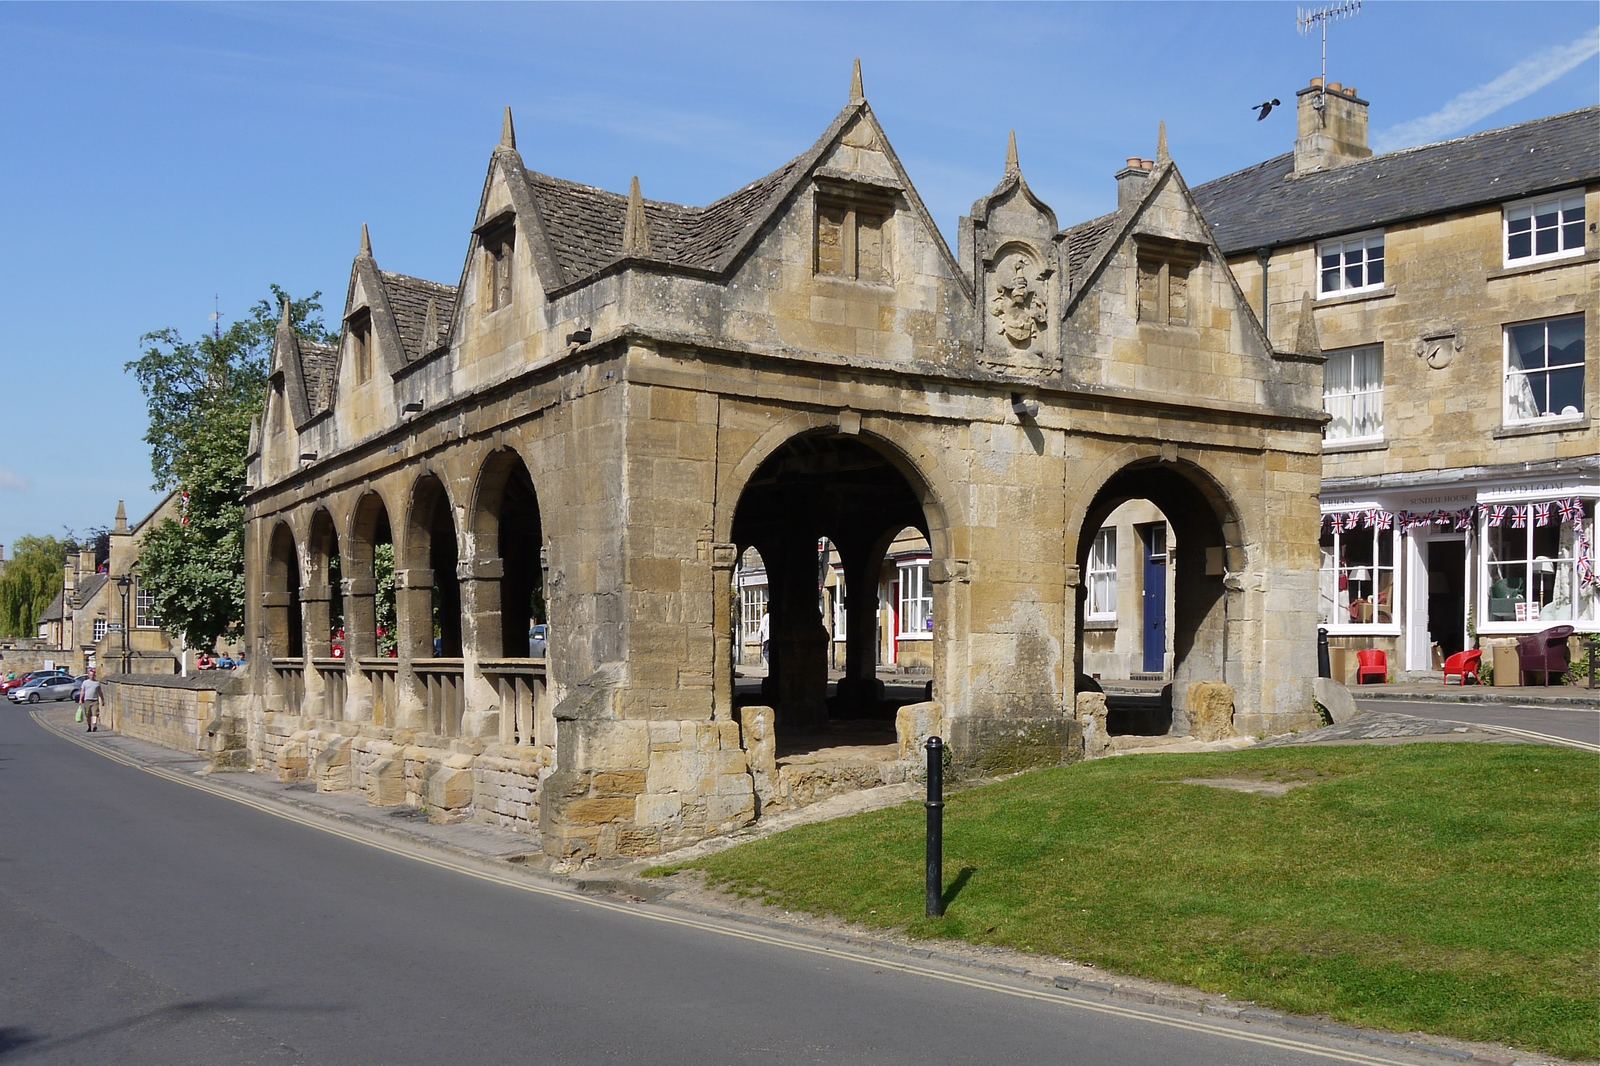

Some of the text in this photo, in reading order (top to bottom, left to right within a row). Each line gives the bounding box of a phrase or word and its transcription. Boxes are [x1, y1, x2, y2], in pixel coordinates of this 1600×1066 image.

[1491, 480, 1565, 496] LLOYD LOOM
[1409, 494, 1470, 505] SUNDIAL HOUSE
